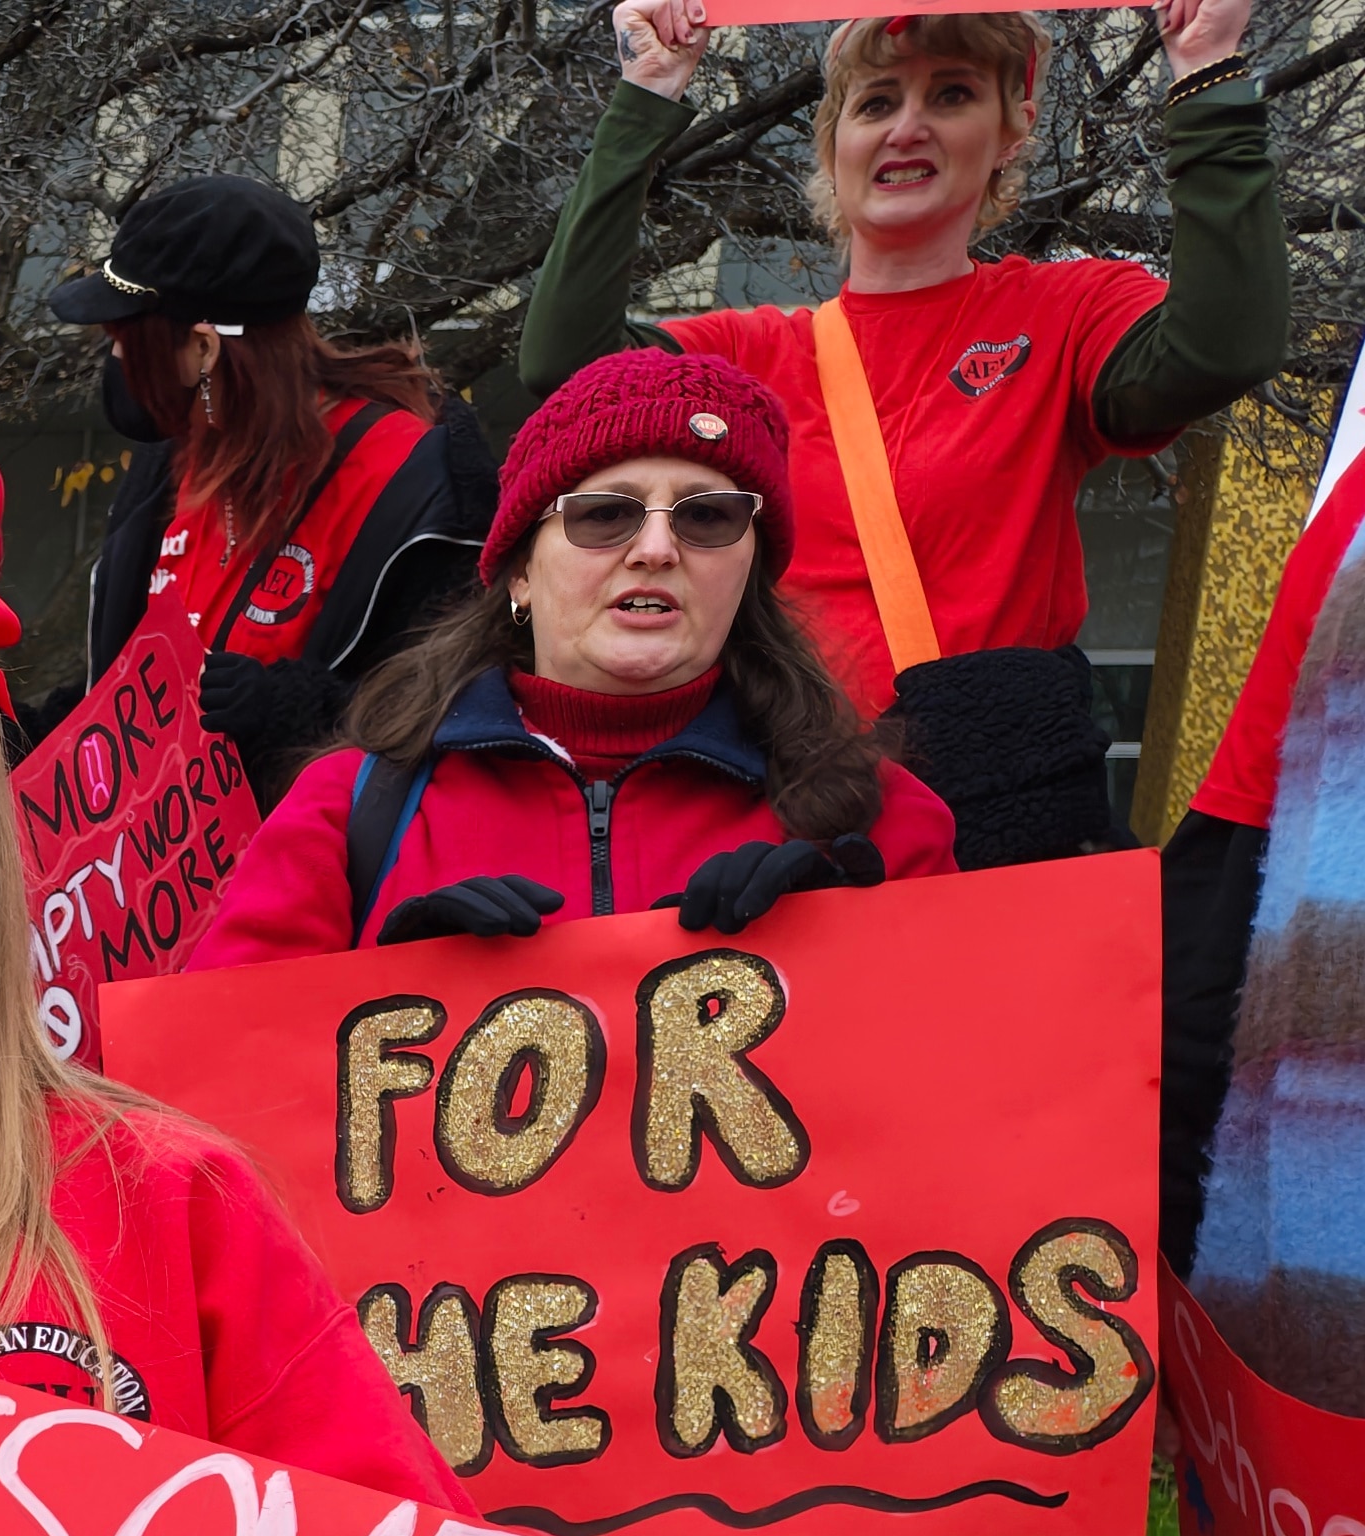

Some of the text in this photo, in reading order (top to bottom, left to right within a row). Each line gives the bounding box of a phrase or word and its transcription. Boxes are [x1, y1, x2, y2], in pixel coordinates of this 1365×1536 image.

[19, 652, 177, 875] MORE
[99, 816, 236, 983] MORE
[334, 946, 811, 1215] FOR
[356, 1216, 1156, 1479] HE KIDS
